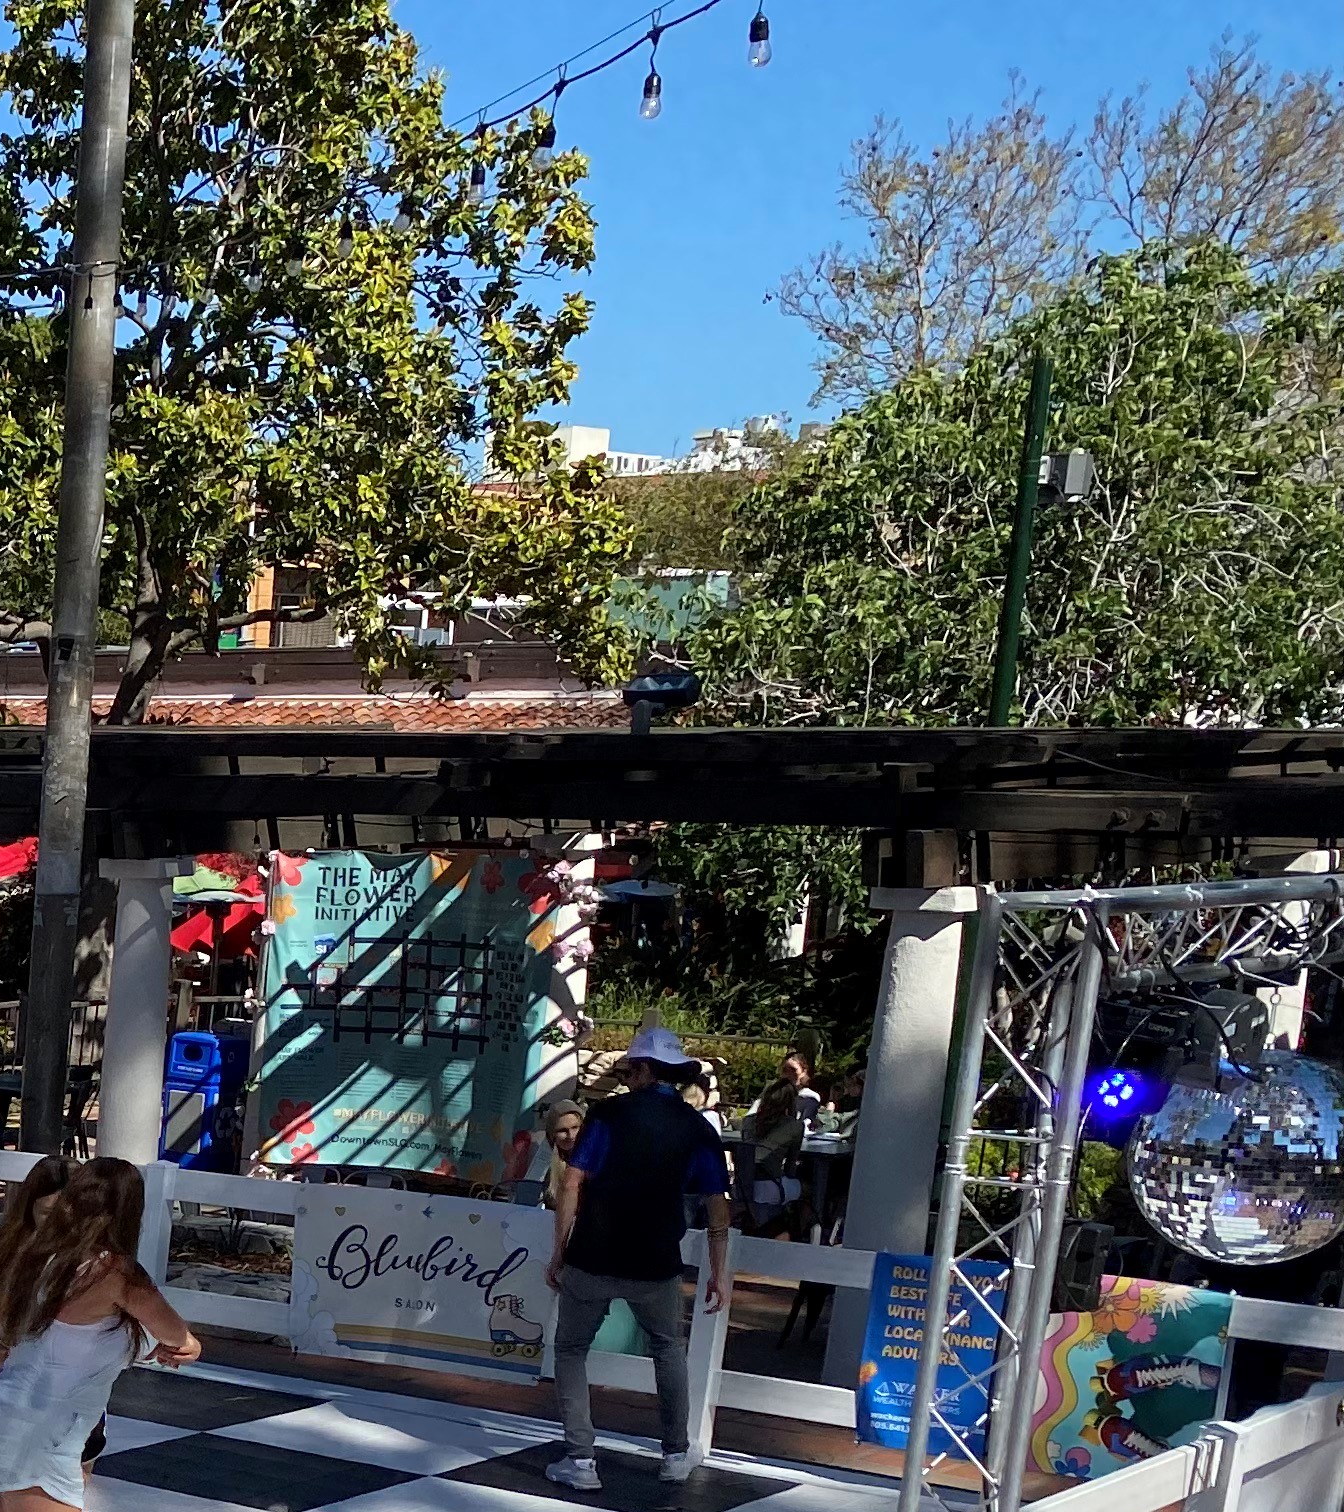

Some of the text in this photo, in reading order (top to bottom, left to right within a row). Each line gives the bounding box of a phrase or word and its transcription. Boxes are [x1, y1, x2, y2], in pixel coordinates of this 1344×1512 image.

[318, 865, 417, 887] THE MAY
[316, 886, 417, 906] FLOWER
[314, 906, 416, 922] INITIATIVE
[316, 1224, 529, 1306] Blubird
[892, 1265, 928, 1282] ROLL
[890, 1286, 928, 1302] BEST
[394, 1297, 437, 1312] SAON
[887, 1304, 926, 1321] WITH
[884, 1325, 924, 1342] LOCA
